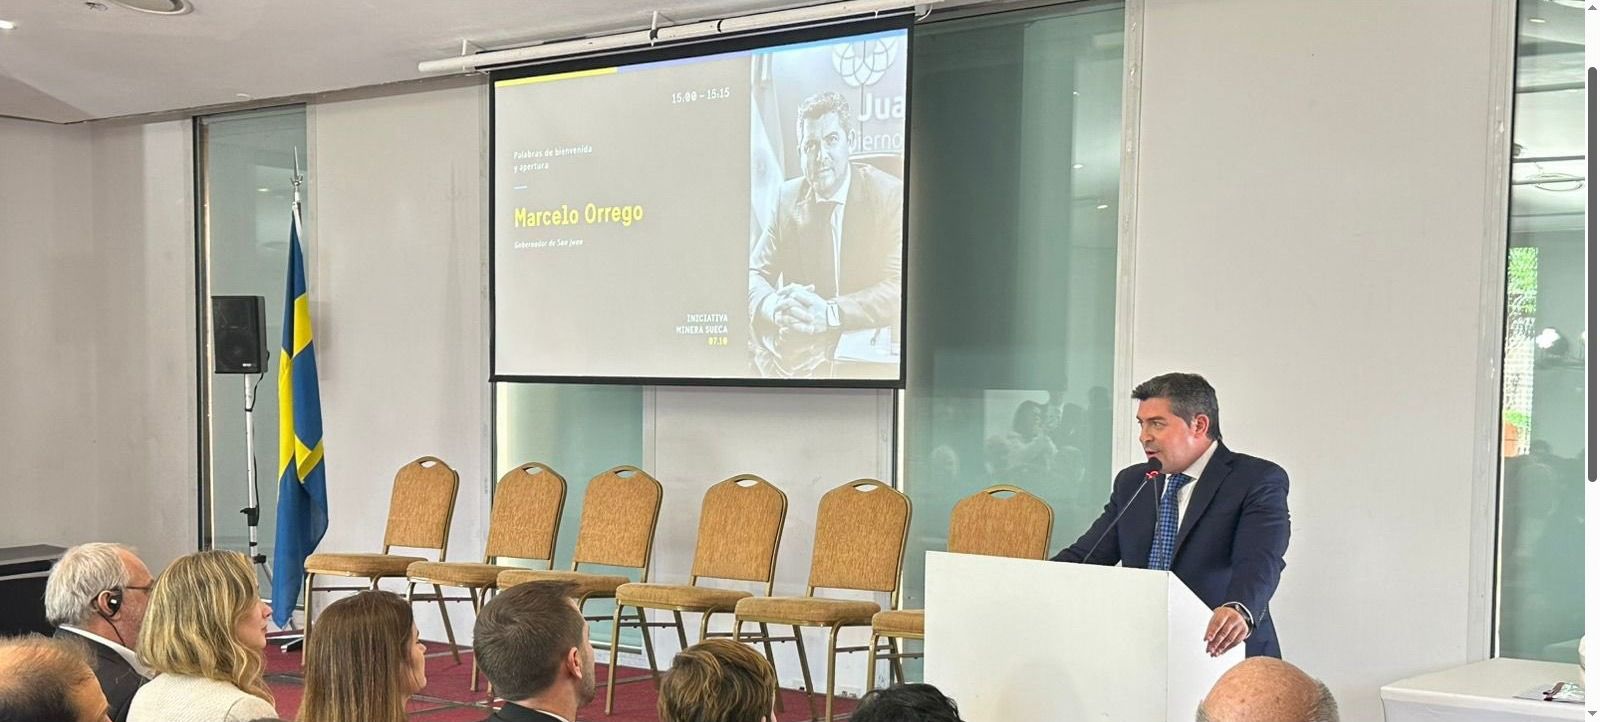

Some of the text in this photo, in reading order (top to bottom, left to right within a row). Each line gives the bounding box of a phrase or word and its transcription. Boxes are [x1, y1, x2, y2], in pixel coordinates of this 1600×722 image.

[513, 144, 593, 160] Palabras de bienvenida
[513, 162, 549, 174] y apertura
[514, 202, 643, 228] Marcelo Orrego
[687, 313, 728, 323] INICIATIVA
[676, 324, 728, 334] MINERA SUECA
[708, 336, 728, 346] 07.10
